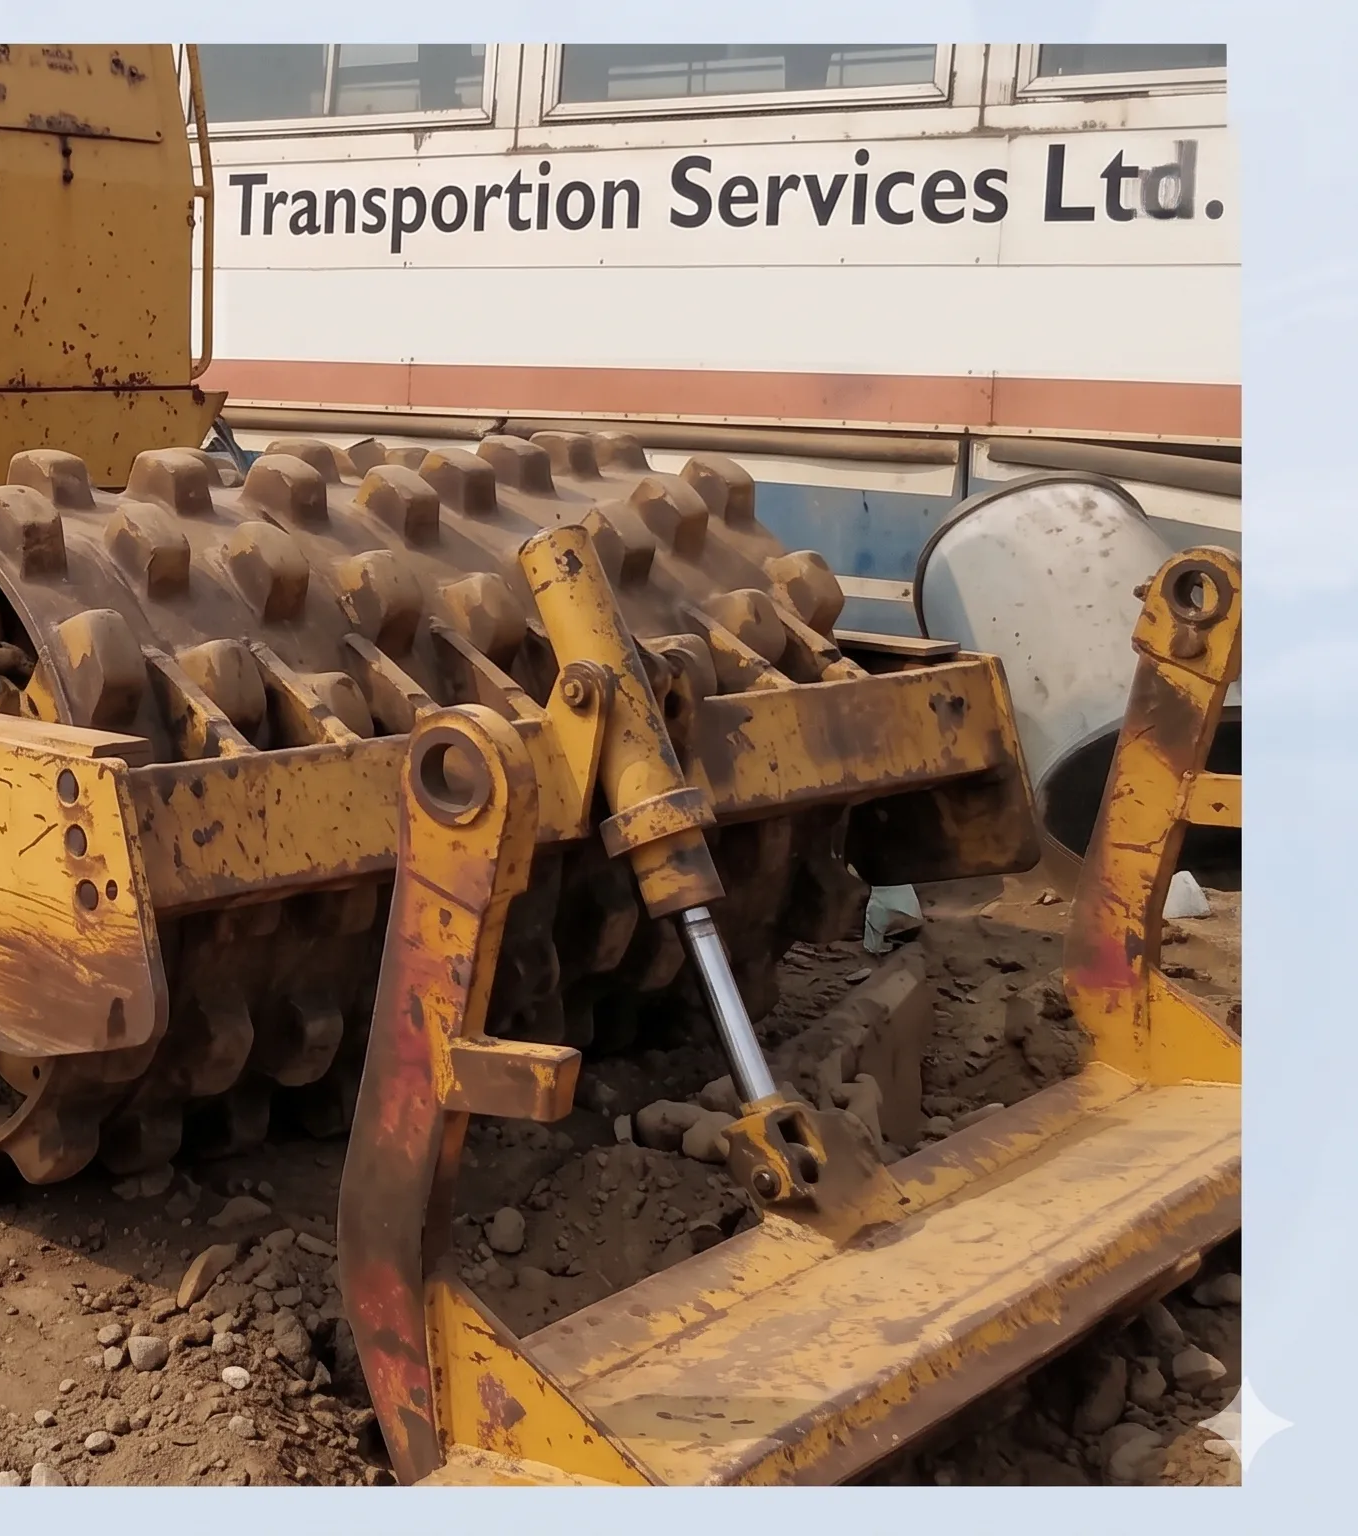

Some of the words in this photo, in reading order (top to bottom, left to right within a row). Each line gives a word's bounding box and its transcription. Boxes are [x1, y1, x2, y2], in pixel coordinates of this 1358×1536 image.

[228, 160, 641, 255] Transportion
[669, 148, 1010, 229] Services
[1043, 139, 1225, 222] Ltd.
